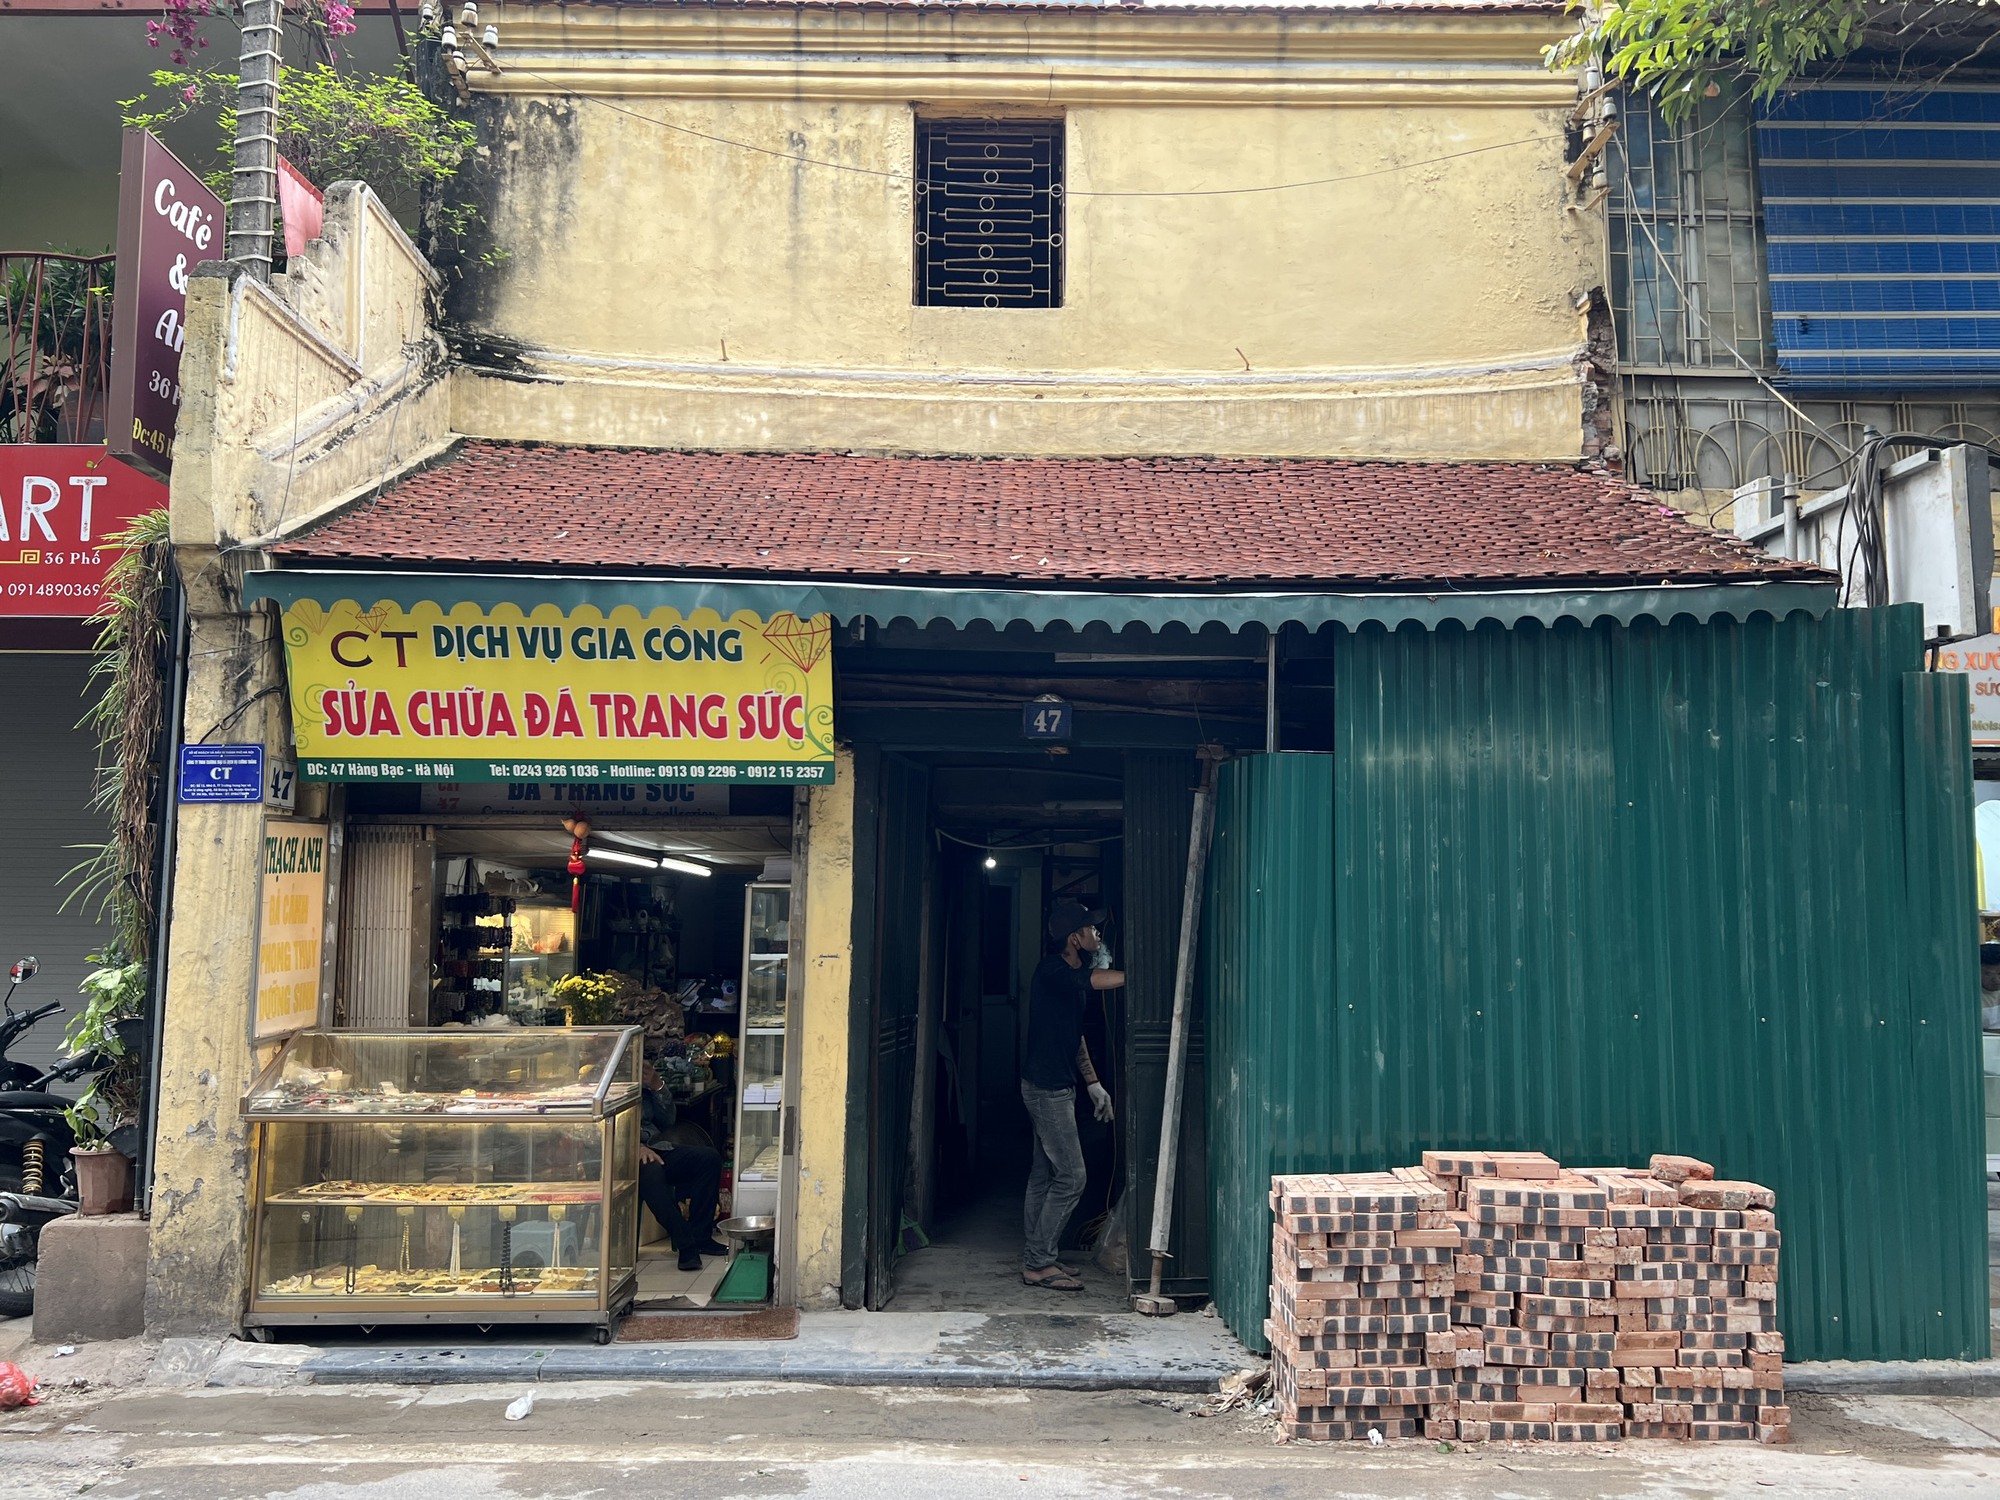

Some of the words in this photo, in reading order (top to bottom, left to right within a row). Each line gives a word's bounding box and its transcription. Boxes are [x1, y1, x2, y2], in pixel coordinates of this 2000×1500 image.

[154, 178, 213, 250] Café
[148, 369, 171, 399] 36
[44, 551, 64, 565] 36
[69, 550, 101, 565] Phố
[8, 583, 101, 596] 0914890369
[330, 630, 418, 668] CT
[433, 625, 510, 663] DỊCH
[516, 626, 563, 664] VỤ
[571, 627, 636, 660] GIA
[643, 624, 743, 662] CÔNG
[322, 680, 400, 737] SỬA
[408, 686, 518, 738] CHỮA
[524, 687, 584, 738] ĐÁ
[590, 693, 728, 738] TRANG
[738, 690, 804, 740] SỨC
[1033, 709, 1062, 733] 47
[209, 766, 233, 780] CT
[270, 767, 294, 800] 47
[307, 763, 328, 776] ĐC:
[330, 763, 344, 776] 47
[348, 763, 378, 777] Hàng
[381, 763, 404, 778] Bạc
[415, 763, 431, 776] Hà
[434, 763, 455, 778] Nội
[489, 764, 510, 776] Tel:
[513, 764, 542, 777] 0243
[545, 765, 567, 777] 926
[570, 765, 598, 777] 1036
[610, 765, 655, 777] Hotline:
[658, 766, 687, 777] 0913
[690, 766, 705, 777] 09
[708, 766, 736, 778] 2296
[748, 766, 776, 778] 0912
[779, 766, 793, 778] 15
[796, 766, 824, 778] 2357
[264, 836, 299, 883] THẠCH
[297, 837, 323, 874] ANH
[259, 940, 292, 975] PHONG
[294, 981, 317, 1014] SINH
